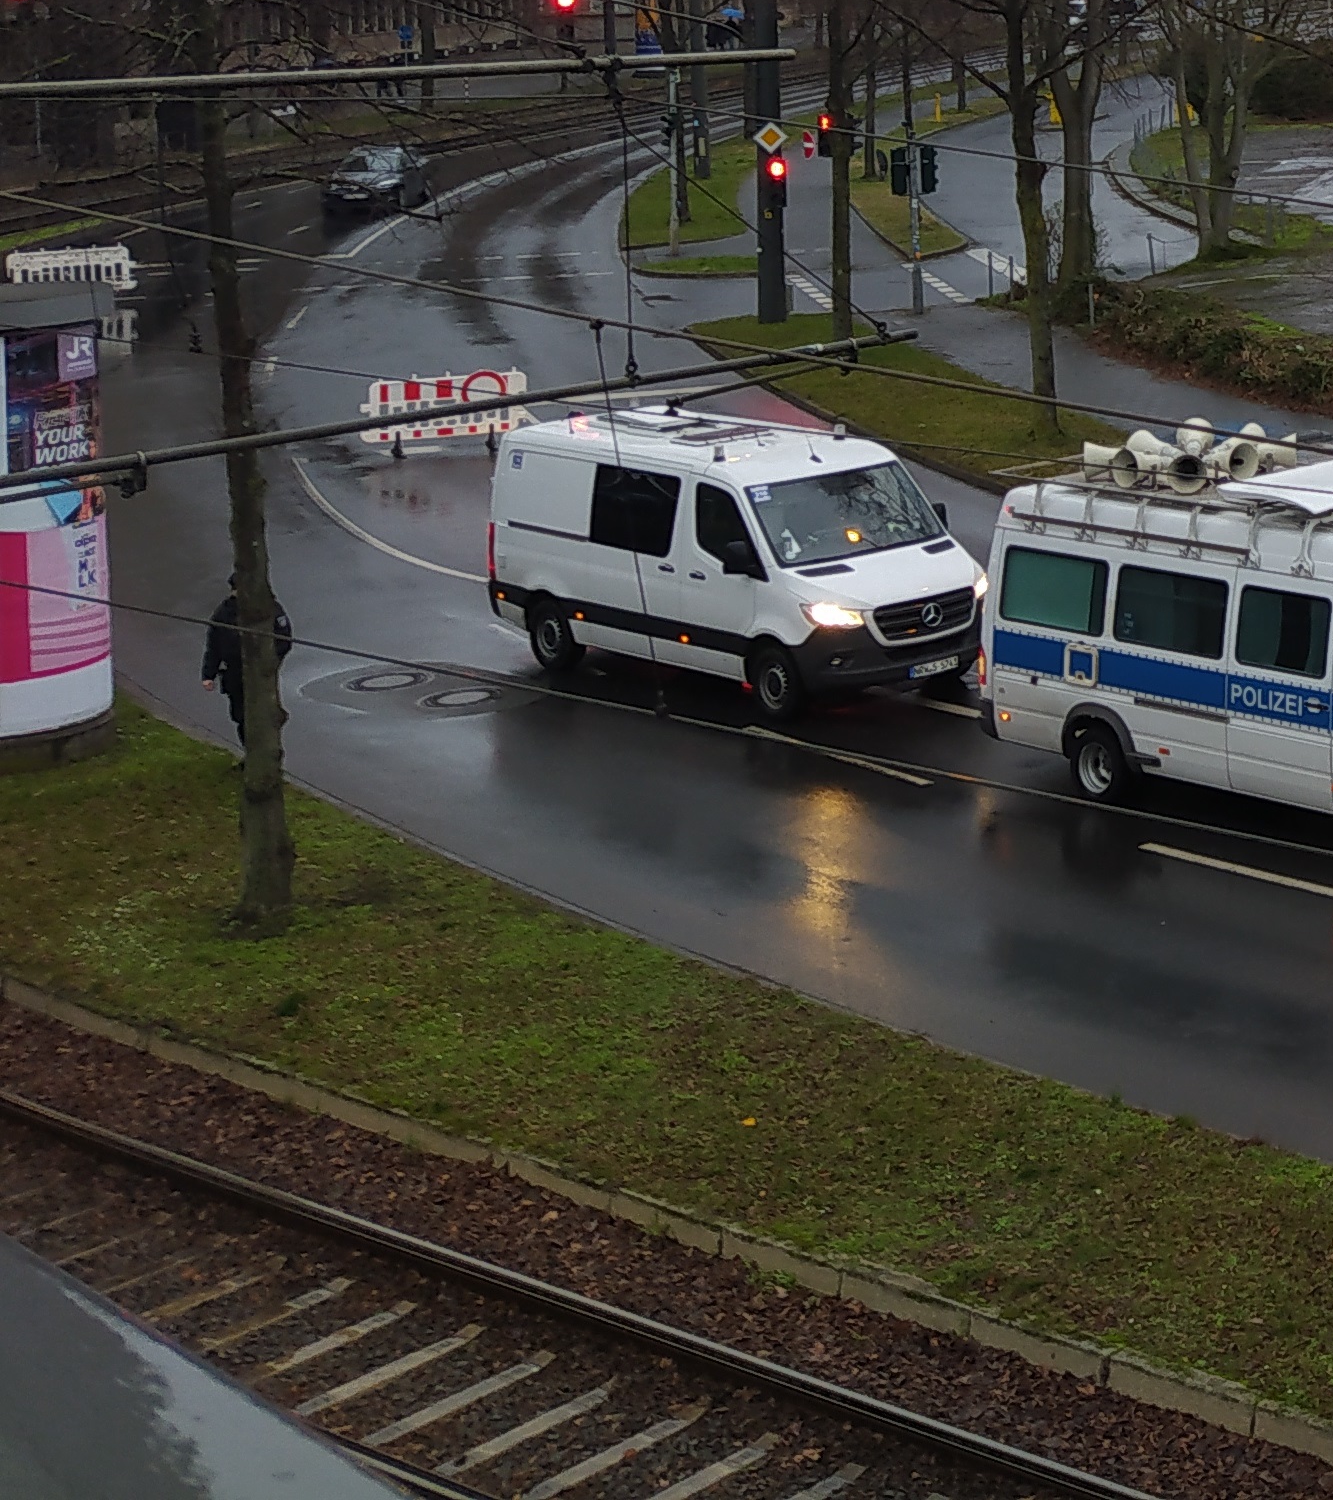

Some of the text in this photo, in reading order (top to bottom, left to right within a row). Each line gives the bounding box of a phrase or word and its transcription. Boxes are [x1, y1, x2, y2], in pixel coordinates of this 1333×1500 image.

[35, 423, 86, 447] YOUR
[35, 440, 91, 465] WORK
[1230, 683, 1303, 717] POLIZEI
